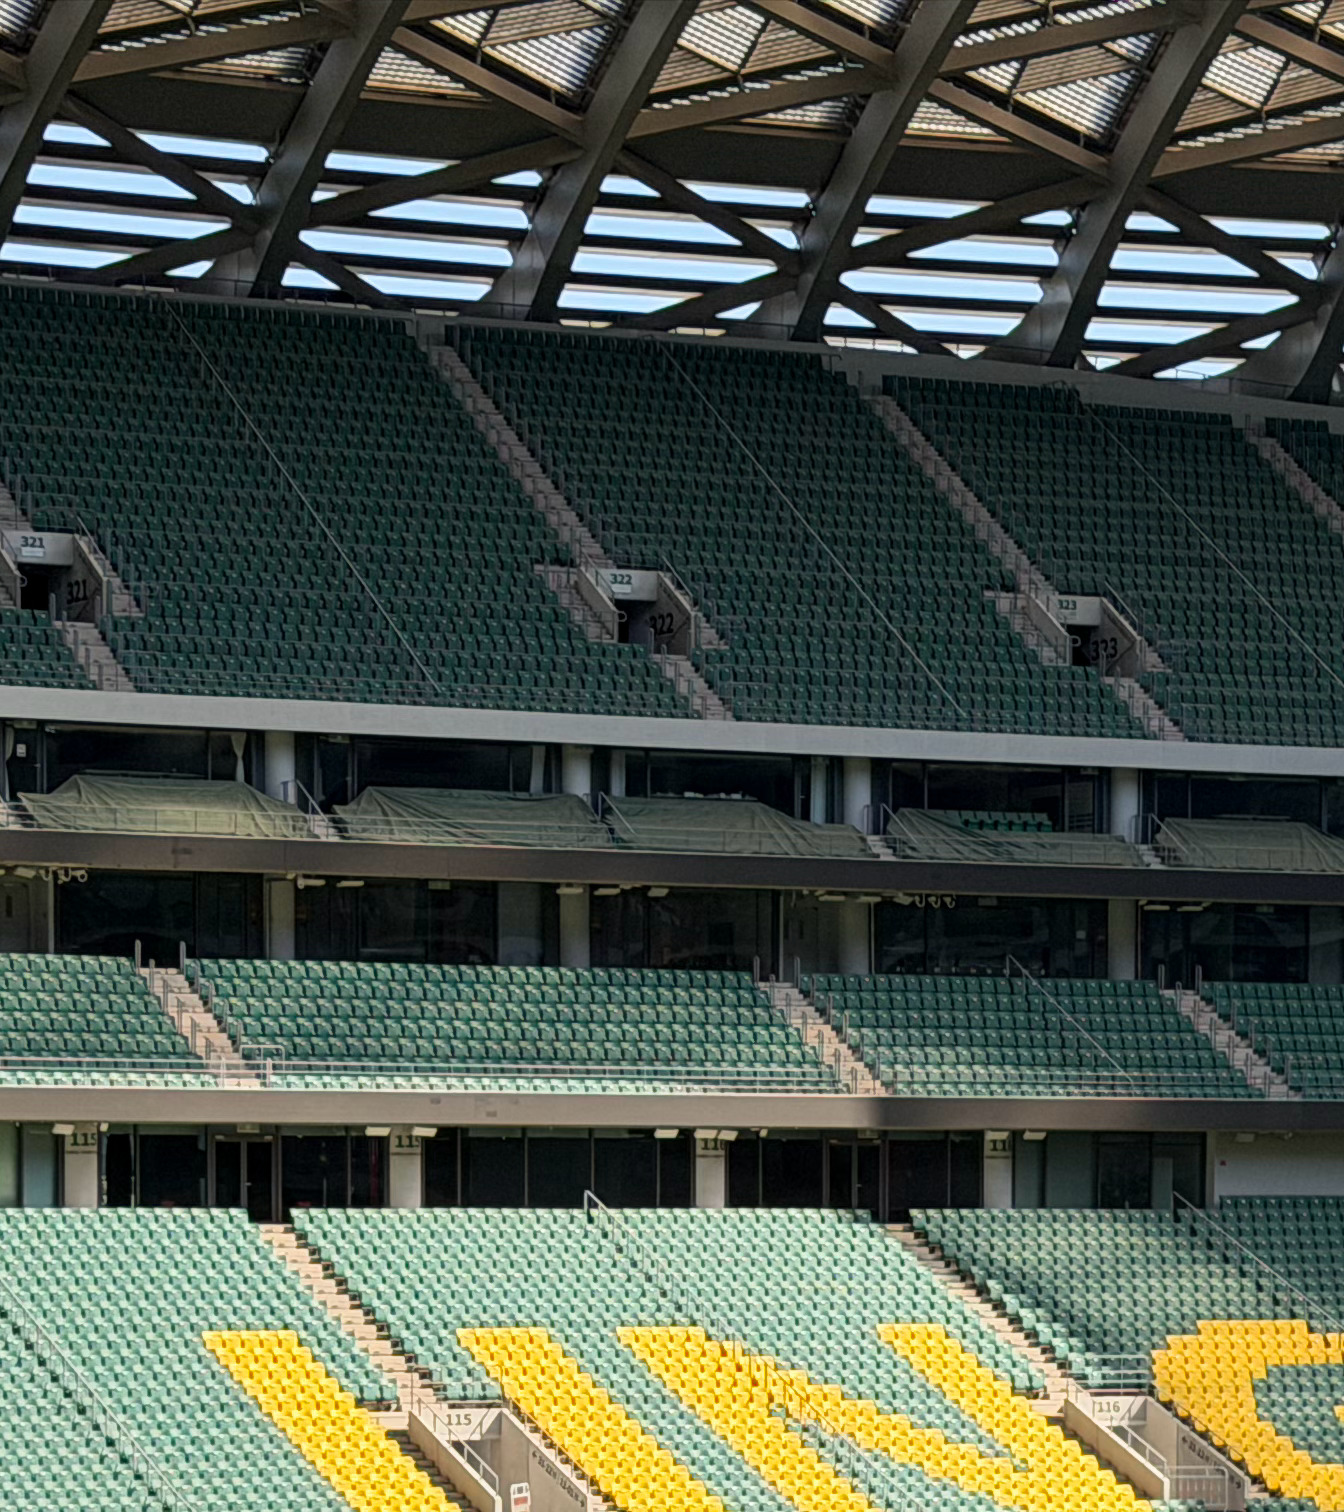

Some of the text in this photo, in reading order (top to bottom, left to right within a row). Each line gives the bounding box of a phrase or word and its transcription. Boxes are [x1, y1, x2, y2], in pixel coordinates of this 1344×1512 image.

[20, 536, 45, 549] 321
[610, 573, 633, 586] 322
[1096, 1401, 1121, 1413] 116
[446, 1413, 472, 1426] 115
